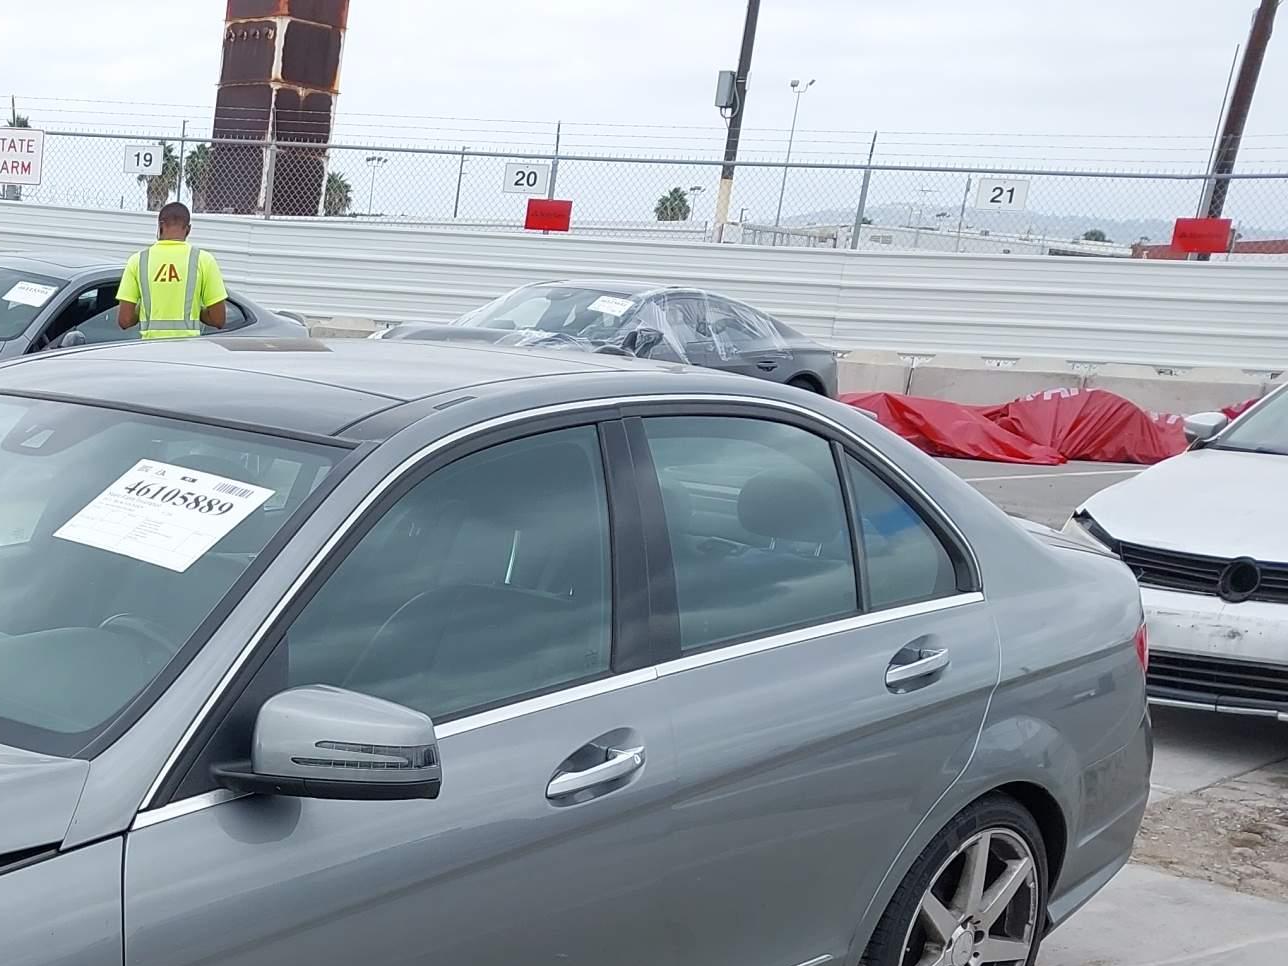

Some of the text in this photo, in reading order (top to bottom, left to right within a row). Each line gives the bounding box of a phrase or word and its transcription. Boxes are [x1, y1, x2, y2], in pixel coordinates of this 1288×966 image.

[134, 152, 153, 168] 19
[514, 170, 537, 187] 20
[989, 186, 1015, 204] 21
[124, 480, 235, 516] 46105889
